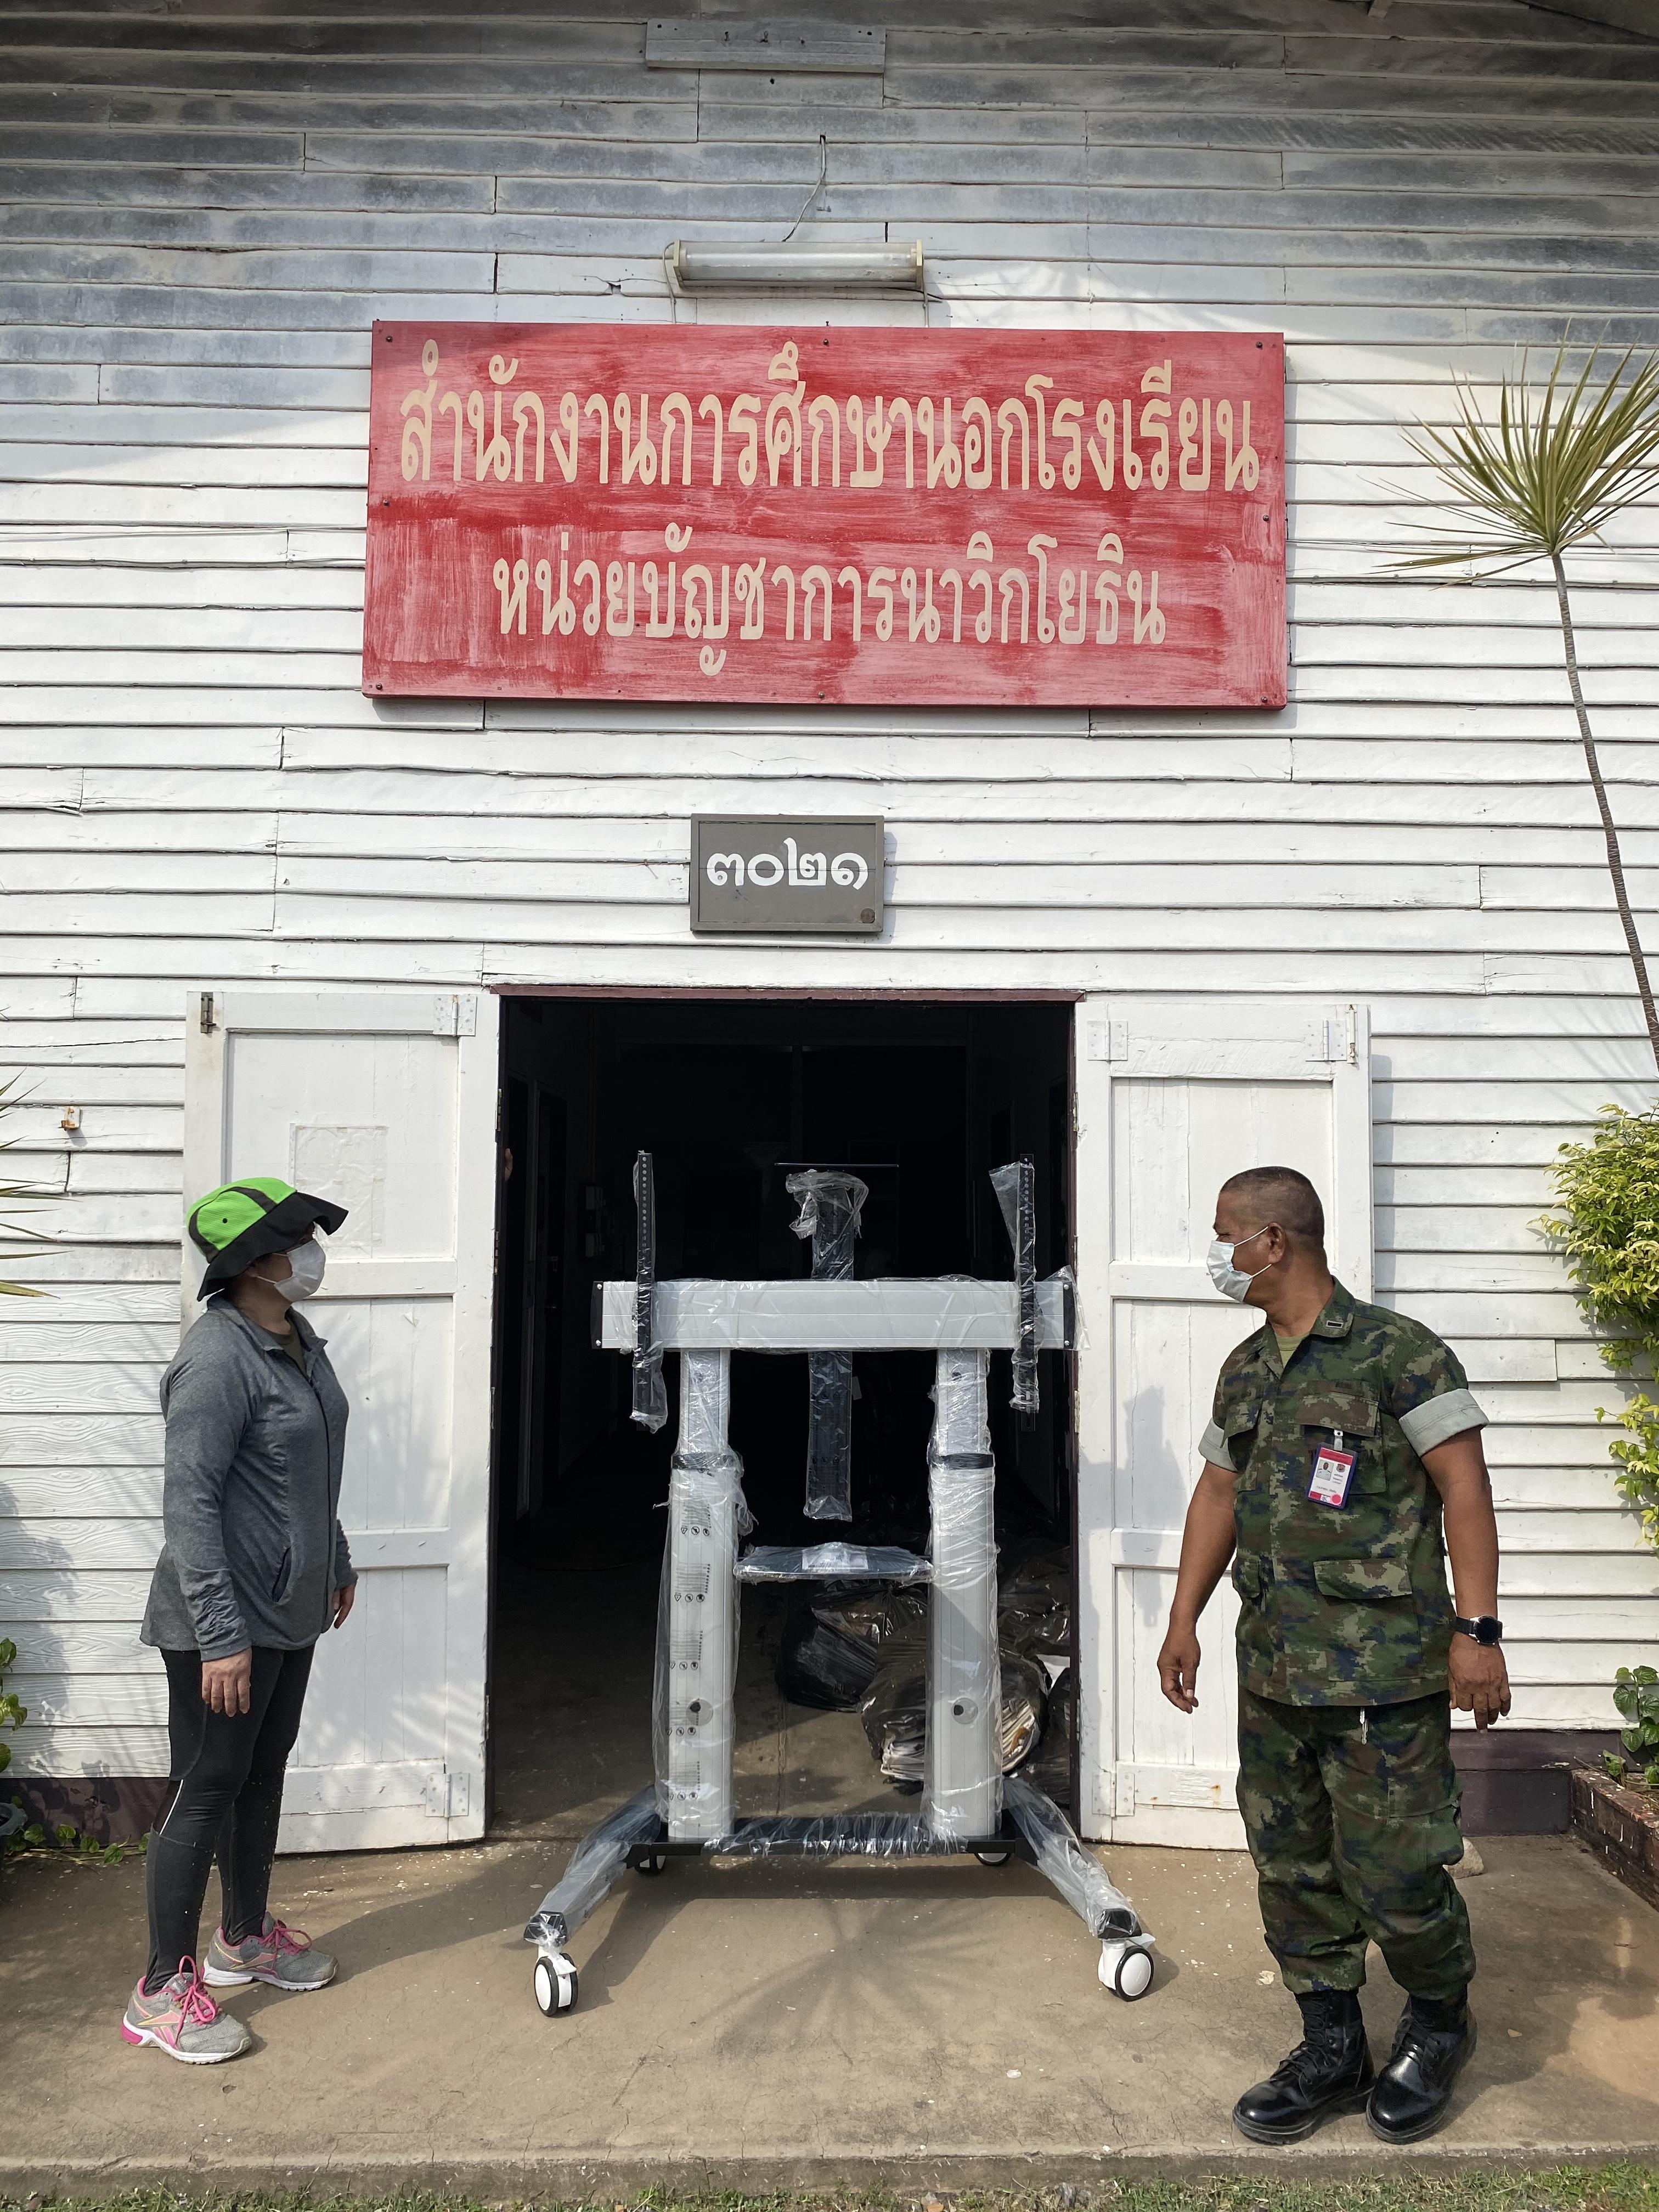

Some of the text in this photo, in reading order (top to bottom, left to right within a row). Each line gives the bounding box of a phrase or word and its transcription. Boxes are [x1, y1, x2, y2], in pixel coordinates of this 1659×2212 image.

[400, 338, 1259, 492] สำนักงานการศึกษานอกโรงเรียน
[493, 522, 1166, 676] หน่วยบัญชาการนาวิกโยธิน
[707, 837, 868, 890] ๓๐๒๑
